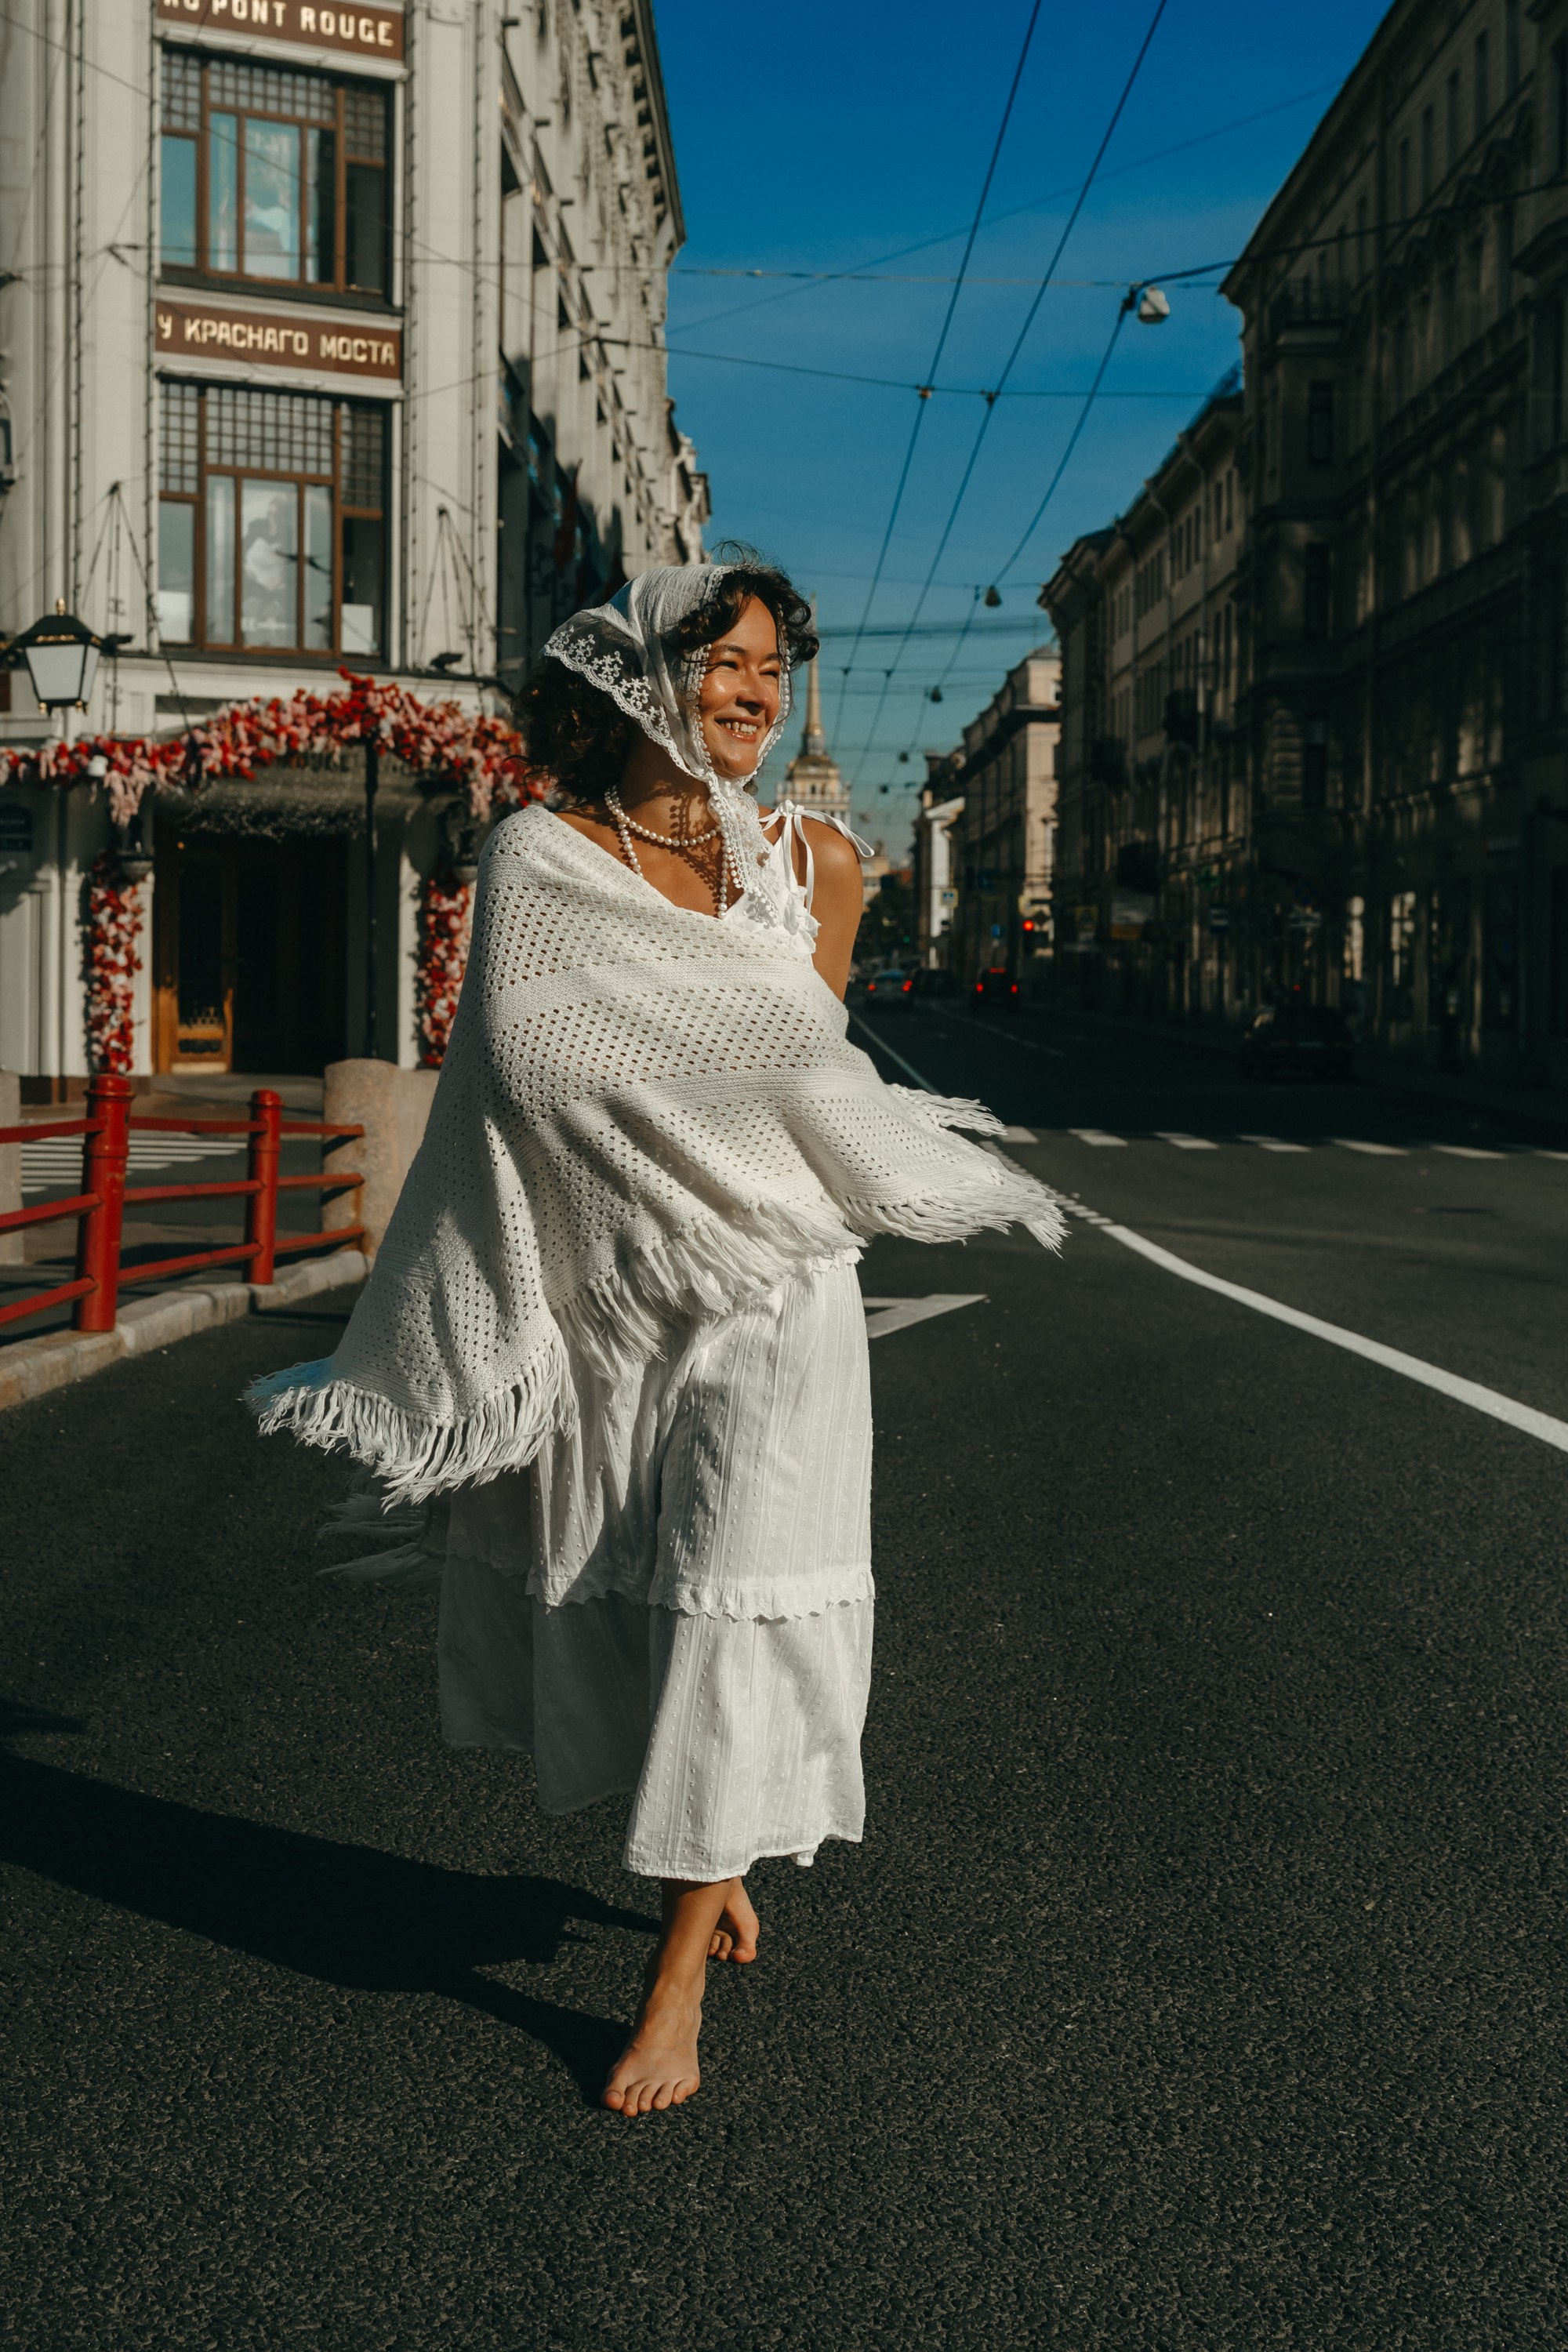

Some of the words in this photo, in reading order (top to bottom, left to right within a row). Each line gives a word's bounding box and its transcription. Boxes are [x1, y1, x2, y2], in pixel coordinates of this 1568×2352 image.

[212, 0, 286, 27] PONT
[299, 6, 394, 47] ROUGE
[158, 314, 172, 339] У
[184, 318, 309, 356] КРАСНАГО
[320, 334, 395, 366] МОСТА
